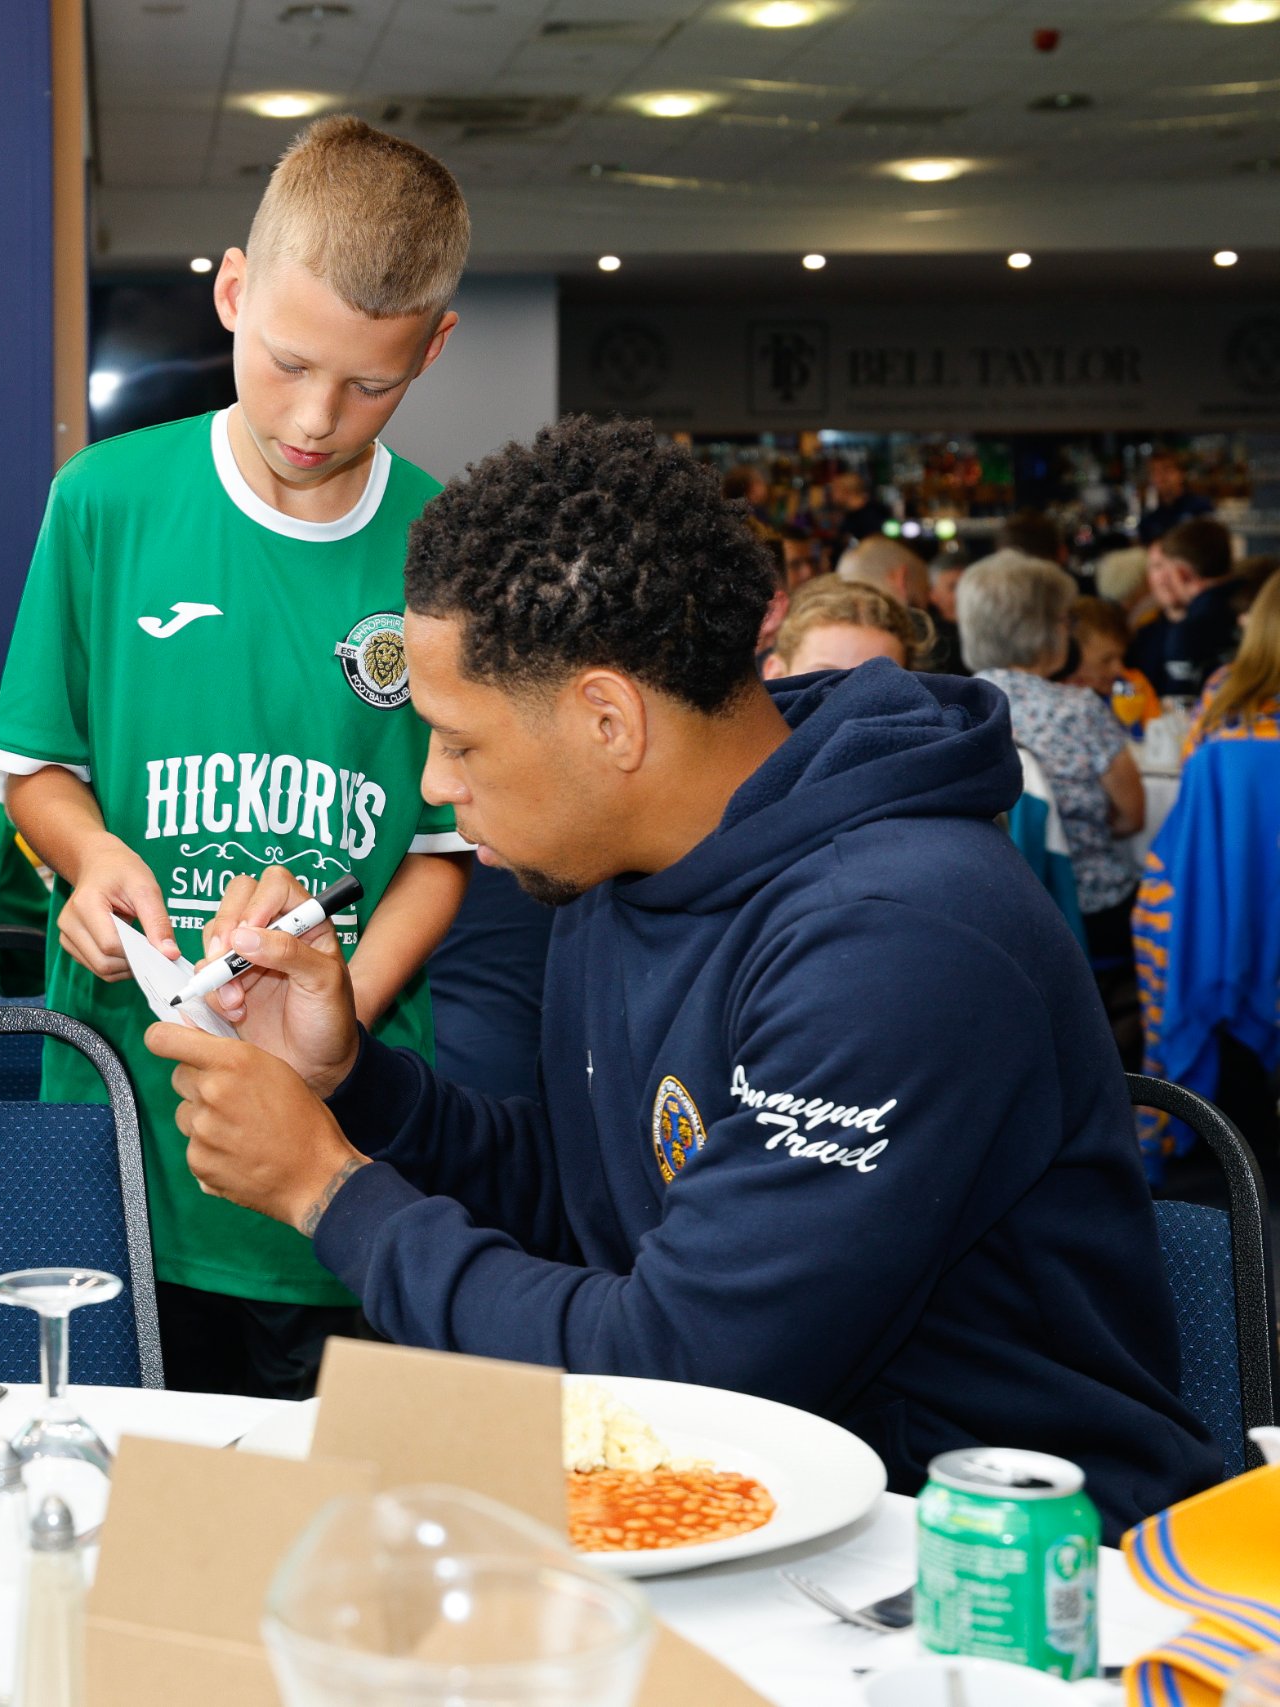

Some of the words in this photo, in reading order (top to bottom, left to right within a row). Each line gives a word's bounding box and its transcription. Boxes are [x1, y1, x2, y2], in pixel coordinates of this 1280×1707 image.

[848, 345, 961, 388] BELL
[969, 345, 1143, 388] TAYLOR
[351, 673, 390, 704] FOOTBALL
[390, 686, 410, 704] CLUB
[145, 752, 387, 860] HICKORY'S
[169, 915, 205, 930] THE
[756, 1112, 890, 1173] Travel
